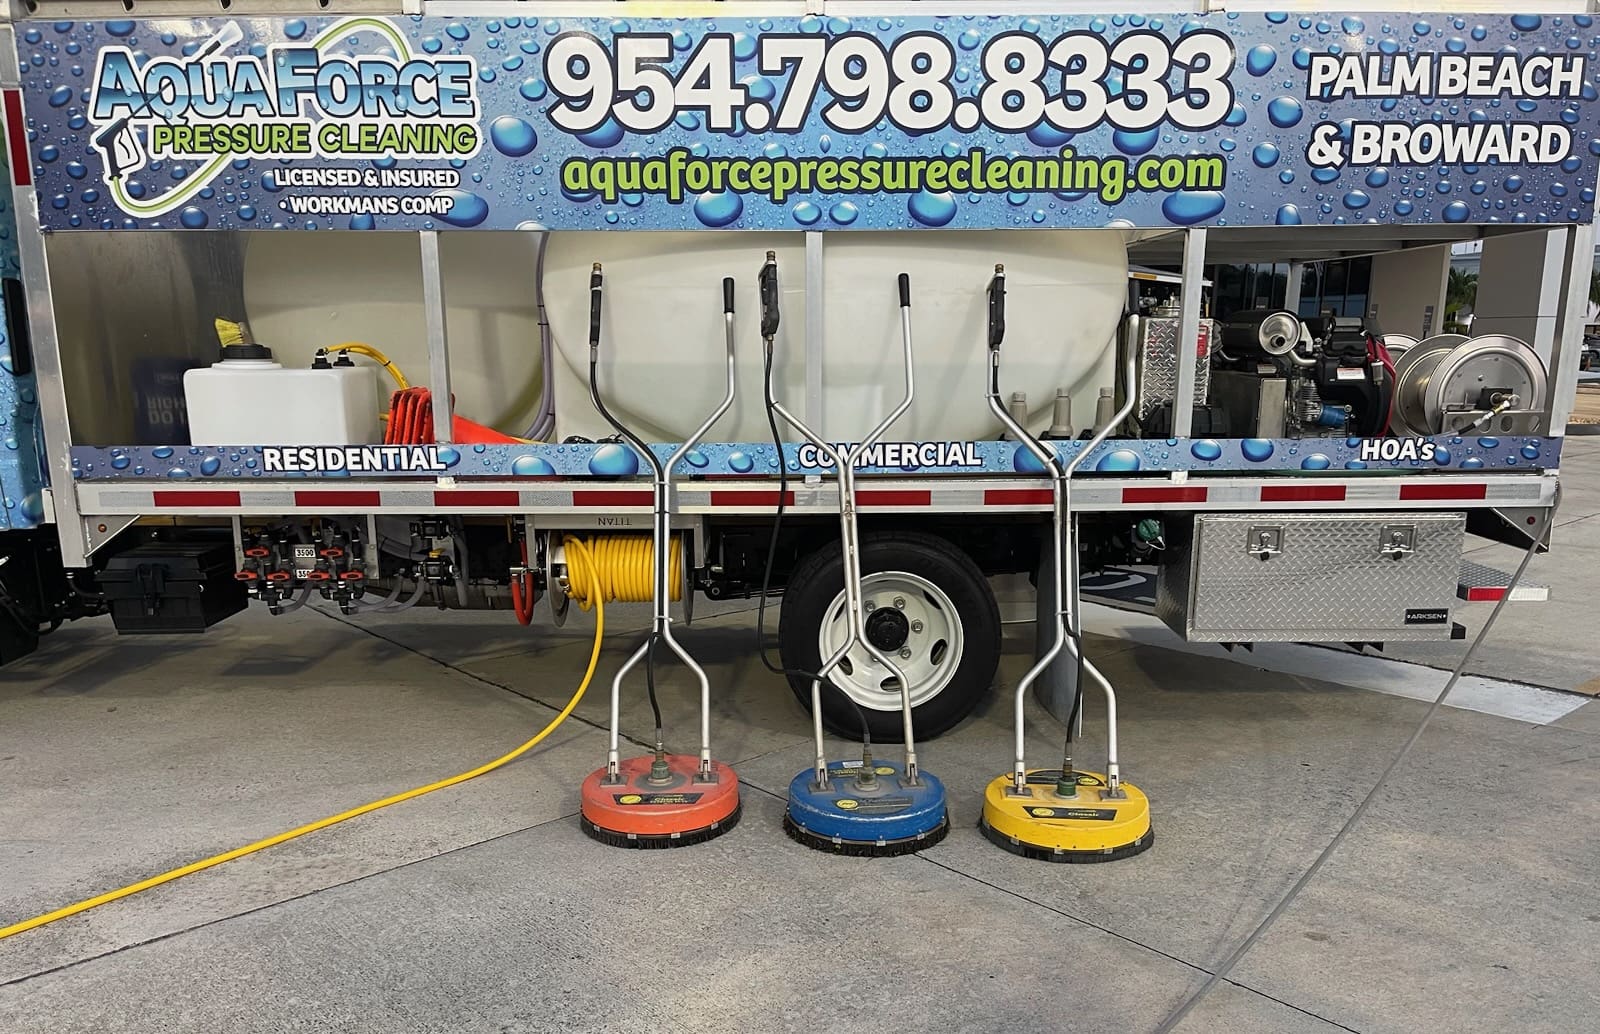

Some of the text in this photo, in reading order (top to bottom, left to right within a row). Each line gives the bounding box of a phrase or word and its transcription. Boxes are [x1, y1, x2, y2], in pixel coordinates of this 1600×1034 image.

[545, 31, 1237, 133] 954.798.8333
[1308, 53, 1585, 98] PALM BEACH
[153, 124, 478, 154] PRESSURE CLEANING
[1307, 122, 1572, 167] & BROWARD
[274, 168, 460, 188] LICENSED & INSURED
[563, 149, 1225, 205] aquaforcepressurecleaning.com
[289, 196, 454, 215] WORKMANS COMP
[262, 446, 448, 472] RESIDENTIAL
[799, 442, 983, 468] COMMERCIAL
[1360, 437, 1437, 461] HOA's
[598, 517, 632, 526] TITAN
[296, 549, 314, 557] 3500
[297, 569, 312, 578] 35
